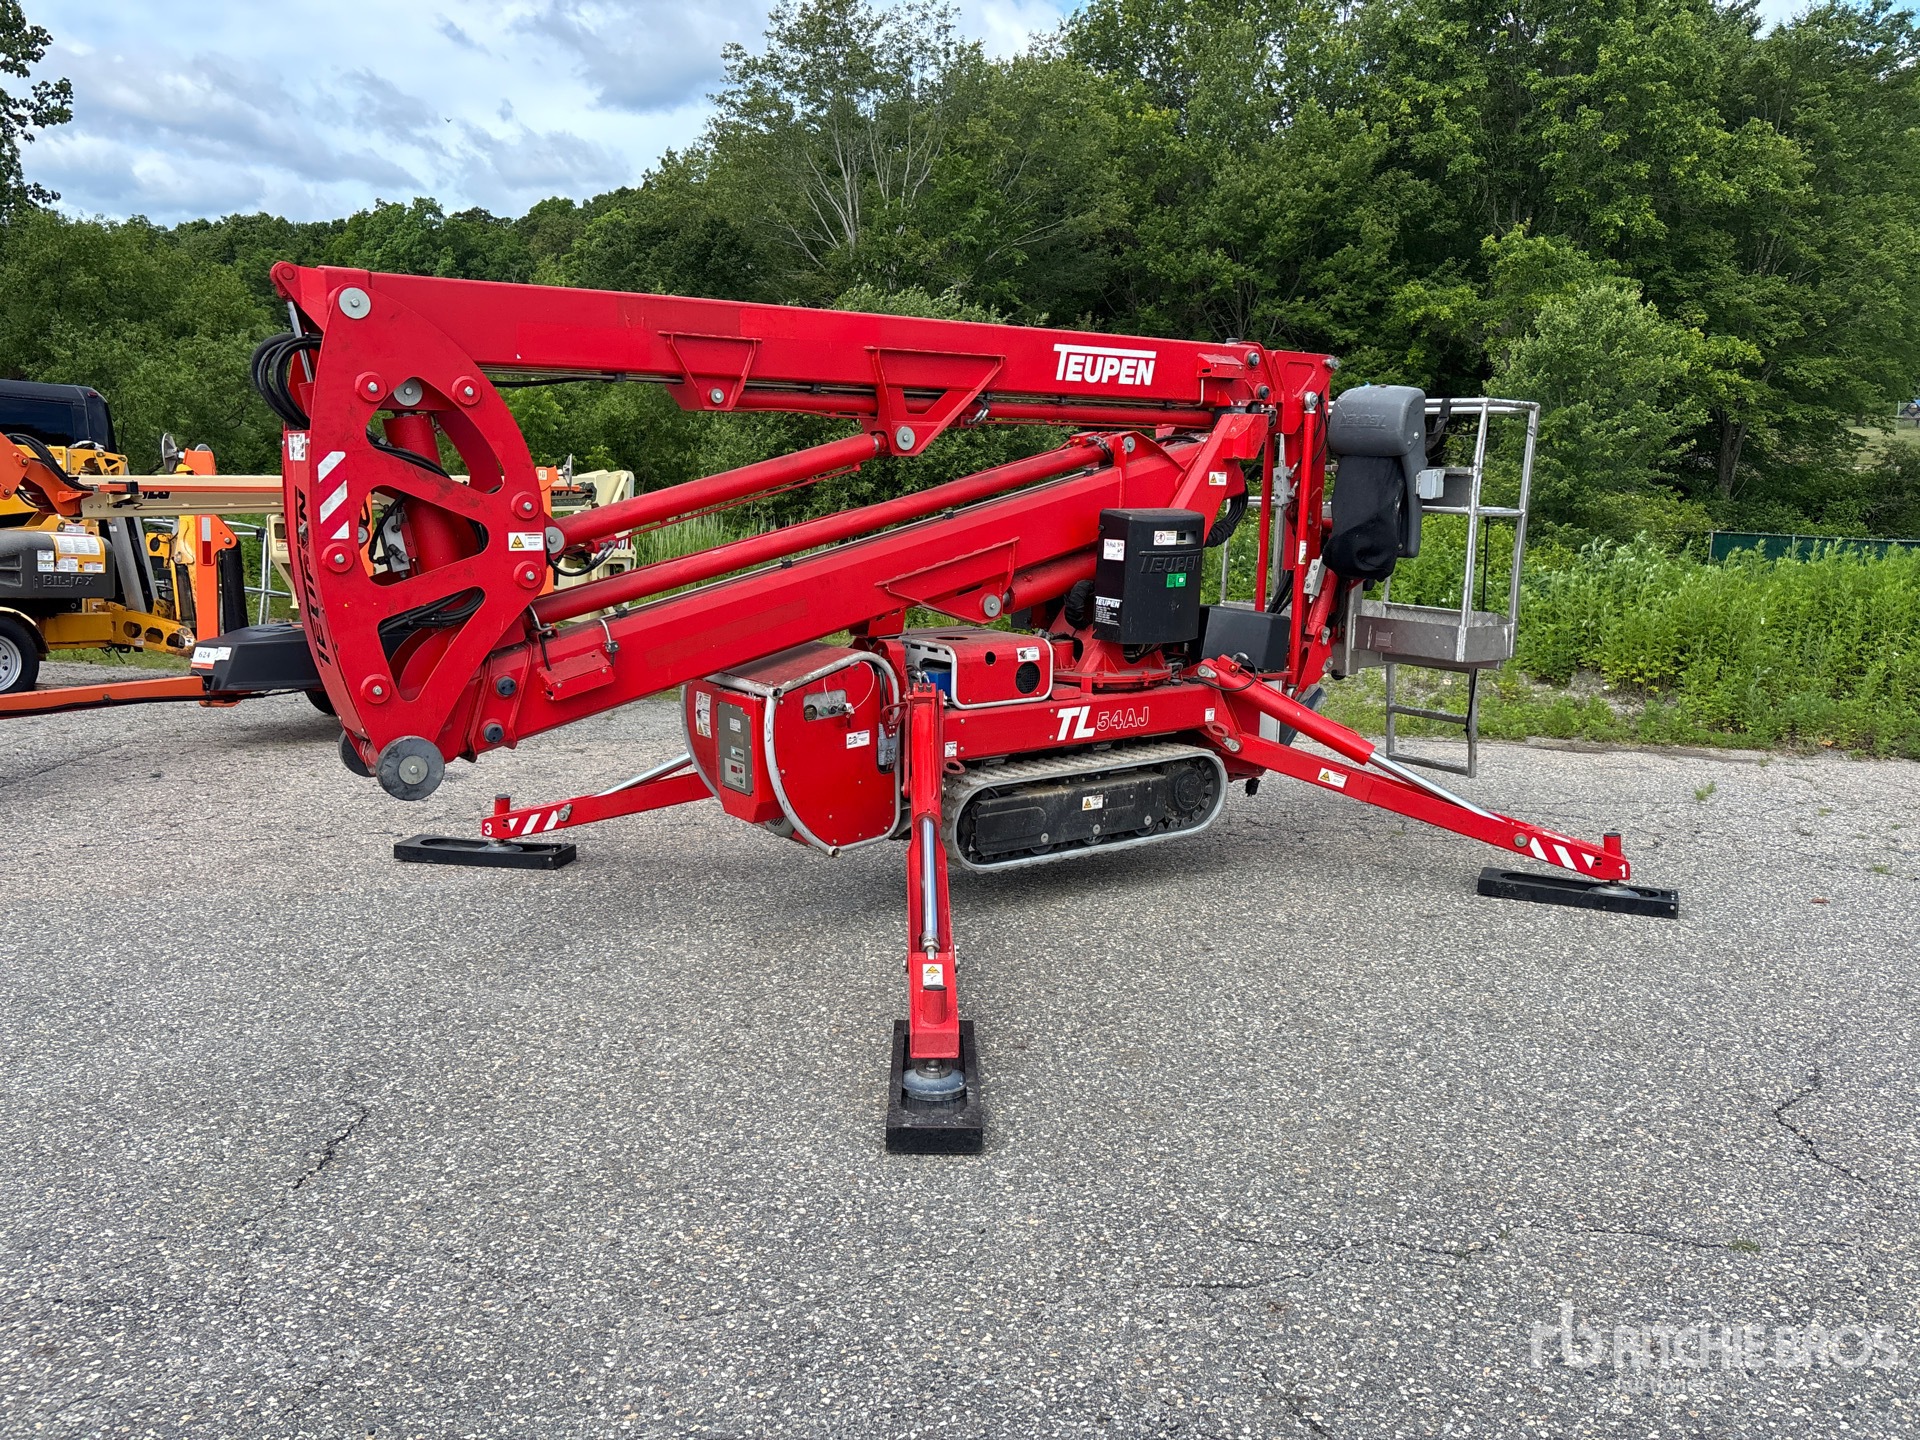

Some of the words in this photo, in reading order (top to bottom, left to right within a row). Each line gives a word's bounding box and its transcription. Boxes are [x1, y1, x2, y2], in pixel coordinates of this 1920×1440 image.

[1053, 343, 1157, 386] TEUPEN
[42, 573, 95, 588] BIL-JAX
[1094, 595, 1122, 609] TEUPEN
[198, 650, 211, 659] 624
[1056, 705, 1096, 741] TL
[1096, 706, 1150, 731] 54AJ
[484, 822, 493, 836] 3
[1618, 863, 1627, 878] 1
